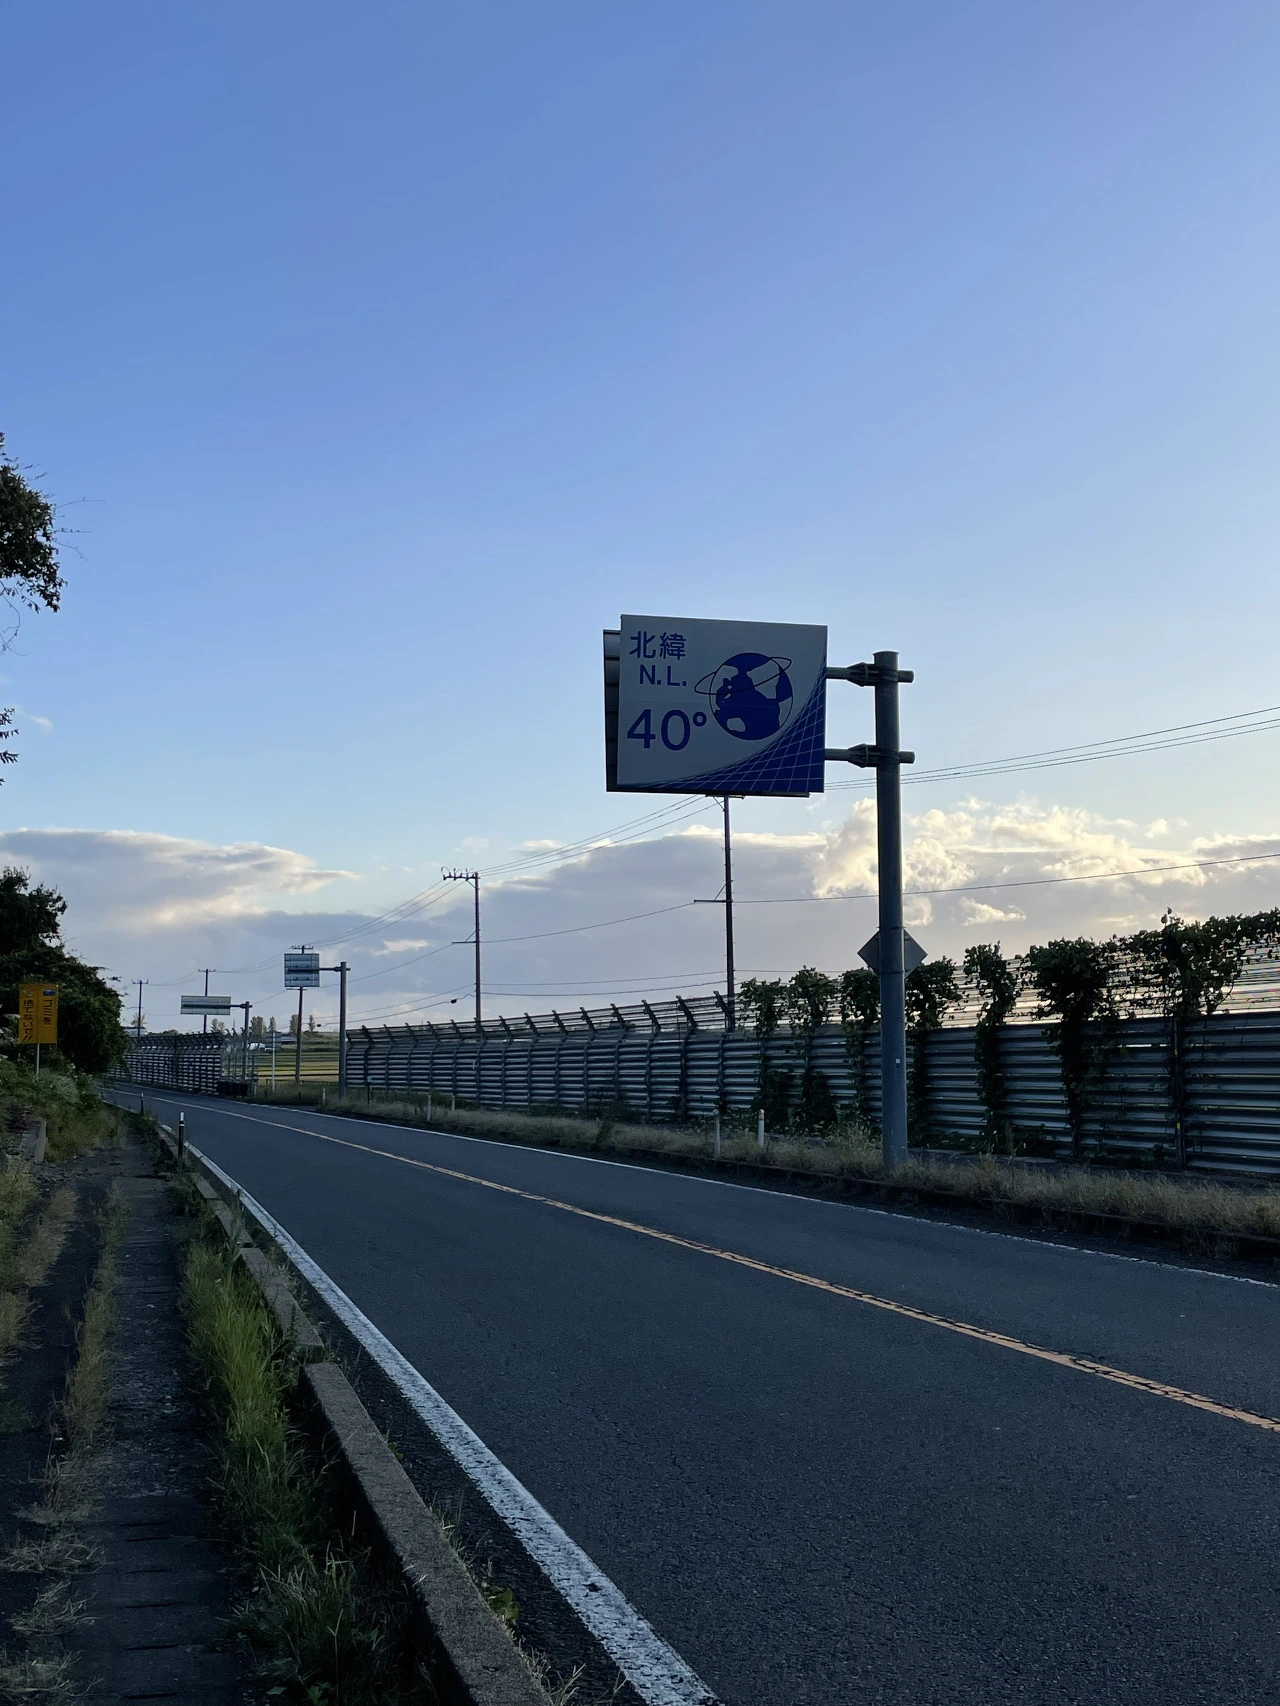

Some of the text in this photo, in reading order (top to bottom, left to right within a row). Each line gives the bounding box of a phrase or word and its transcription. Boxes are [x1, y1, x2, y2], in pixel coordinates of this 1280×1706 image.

[629, 631, 687, 661] 北緯
[639, 664, 688, 687] N.L.
[43, 999, 53, 1026] ゴミを
